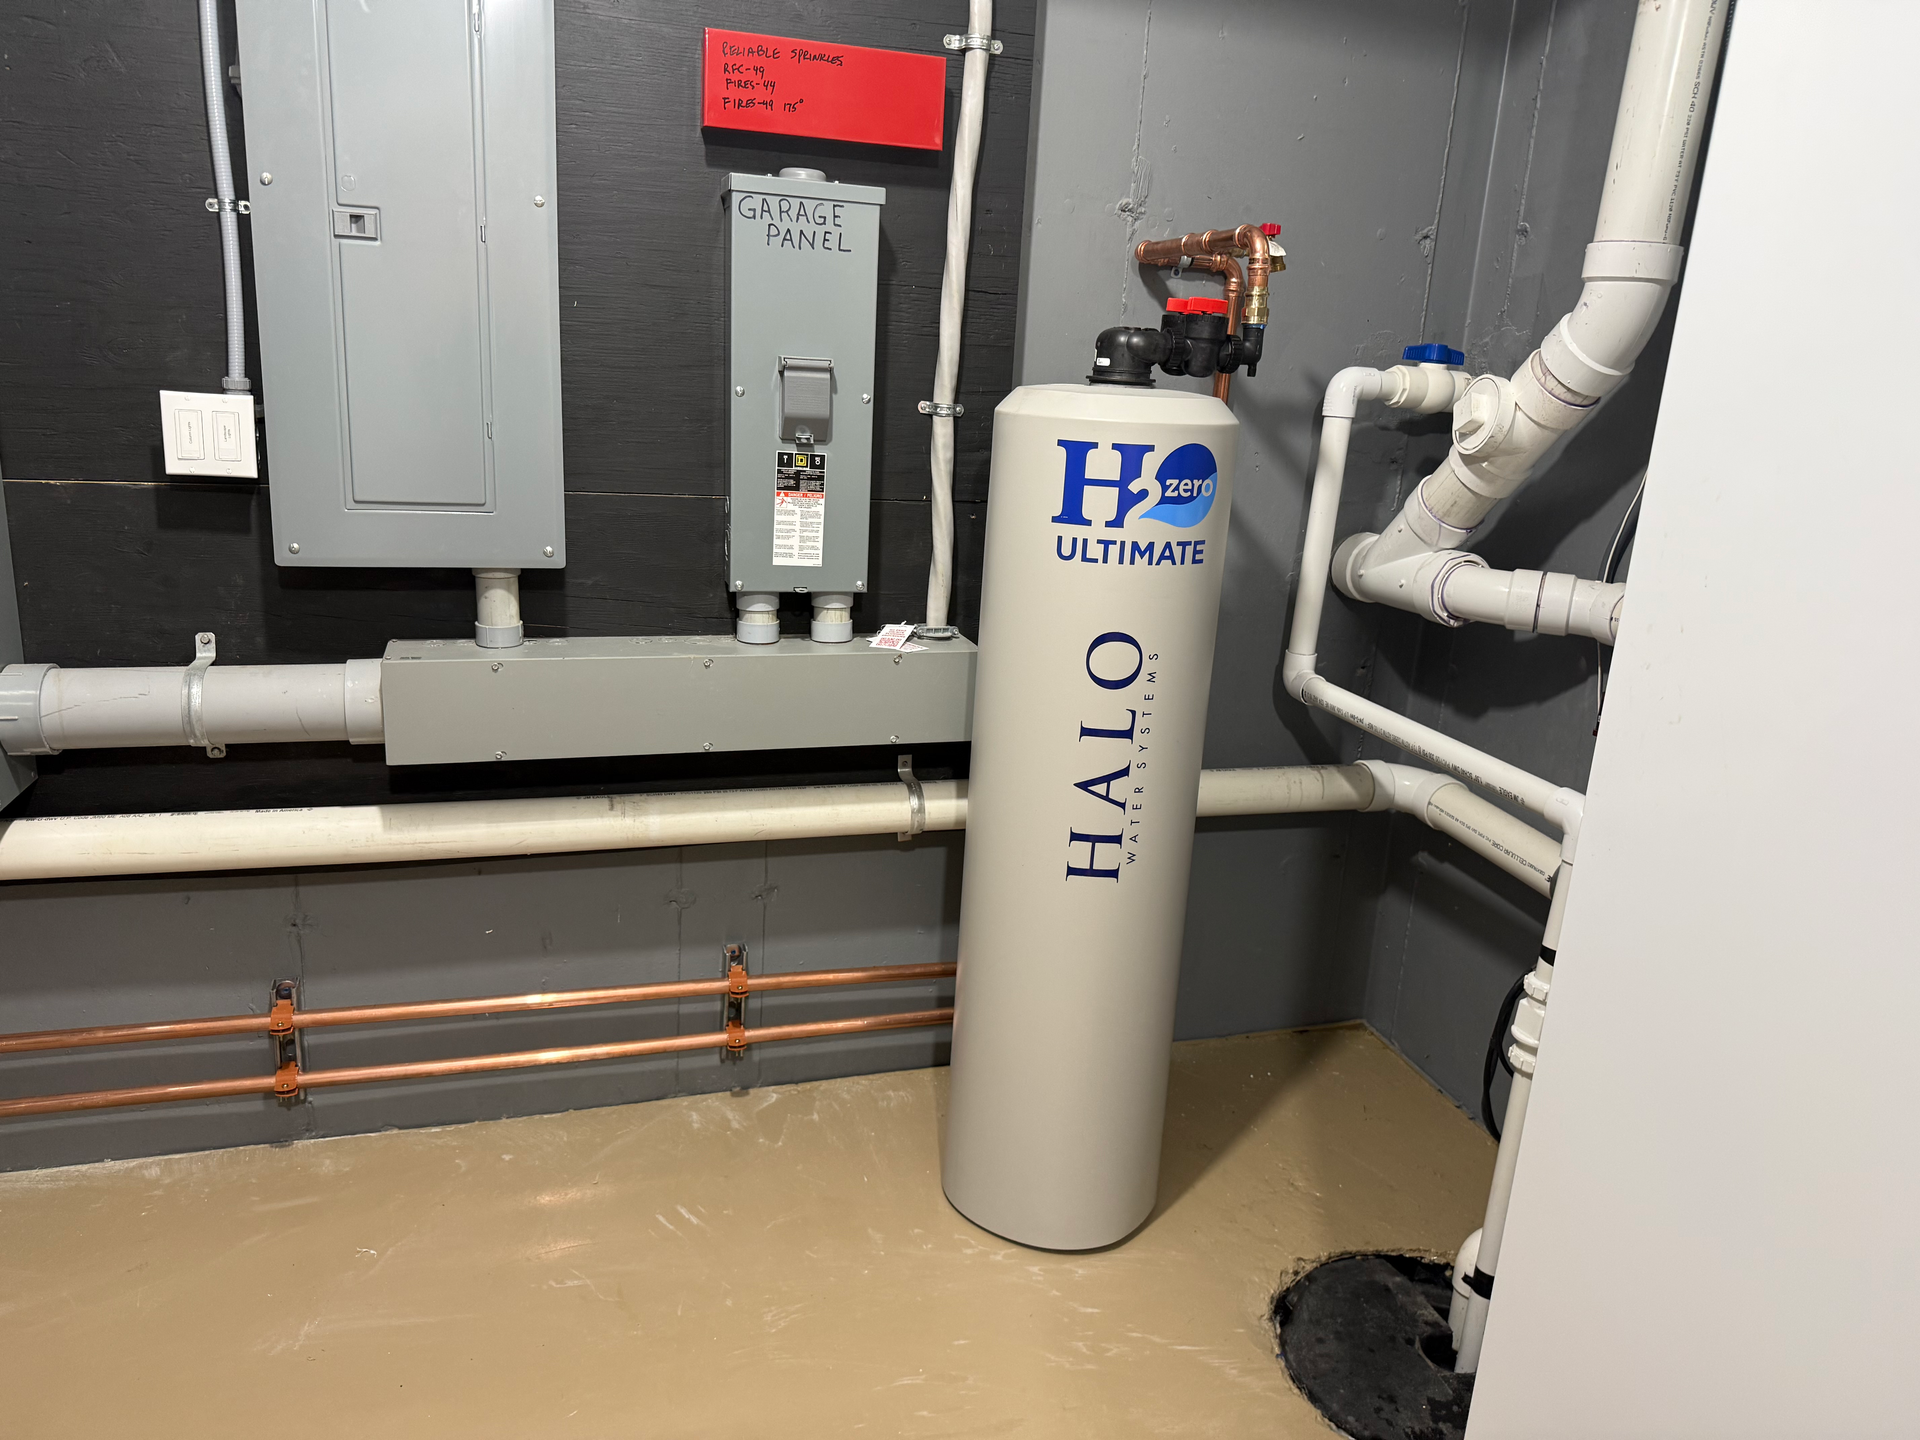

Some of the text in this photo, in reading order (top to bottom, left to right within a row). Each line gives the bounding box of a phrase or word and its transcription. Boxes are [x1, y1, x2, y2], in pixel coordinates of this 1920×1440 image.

[722, 41, 844, 66] RELIABLE SPRINKLES
[724, 63, 765, 80] RFC-49
[1692, 80, 1701, 99] SCH
[1689, 100, 1697, 112] 40
[738, 194, 845, 227] GARAGE
[766, 223, 852, 253] PANEL
[1164, 478, 1214, 497] zero
[1056, 535, 1206, 566] ULTIMATE
[1065, 631, 1143, 884] HALO
[1126, 653, 1159, 865] WATER SYSTEMS
[1491, 840, 1504, 851] CORE
[1504, 848, 1527, 866] CELLULAR
